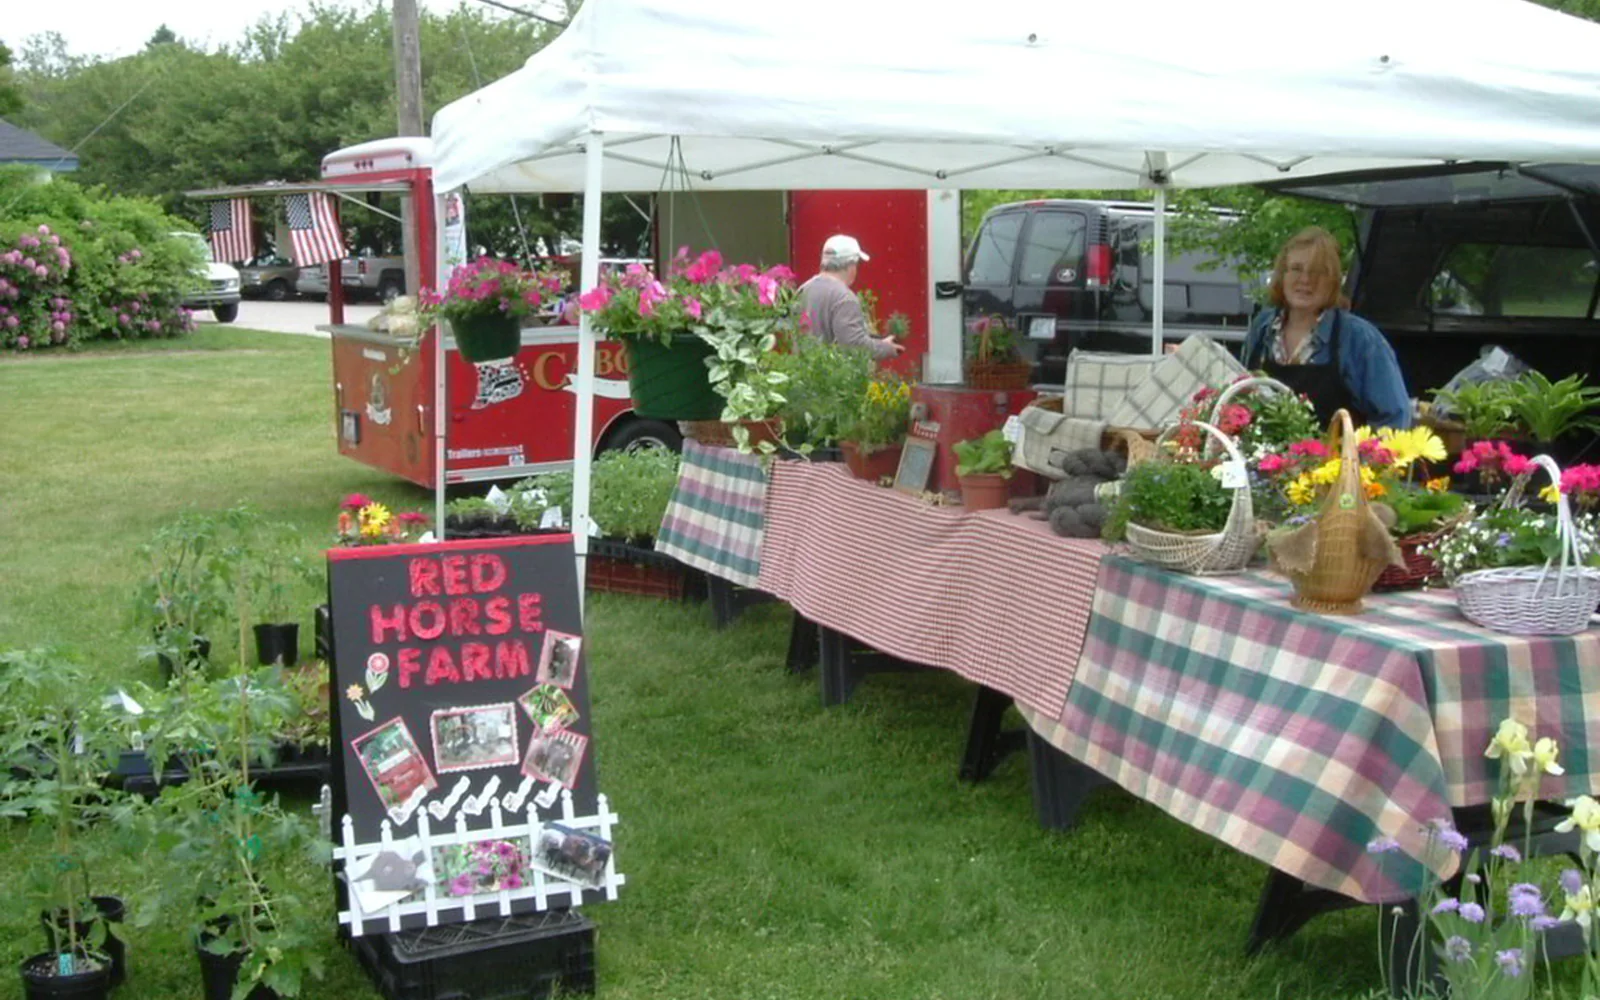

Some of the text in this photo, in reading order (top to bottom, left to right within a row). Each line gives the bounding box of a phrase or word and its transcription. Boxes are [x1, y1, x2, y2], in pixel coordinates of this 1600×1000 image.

[409, 553, 507, 597] RED
[370, 592, 544, 645] HORSE
[397, 640, 531, 689] FARM
